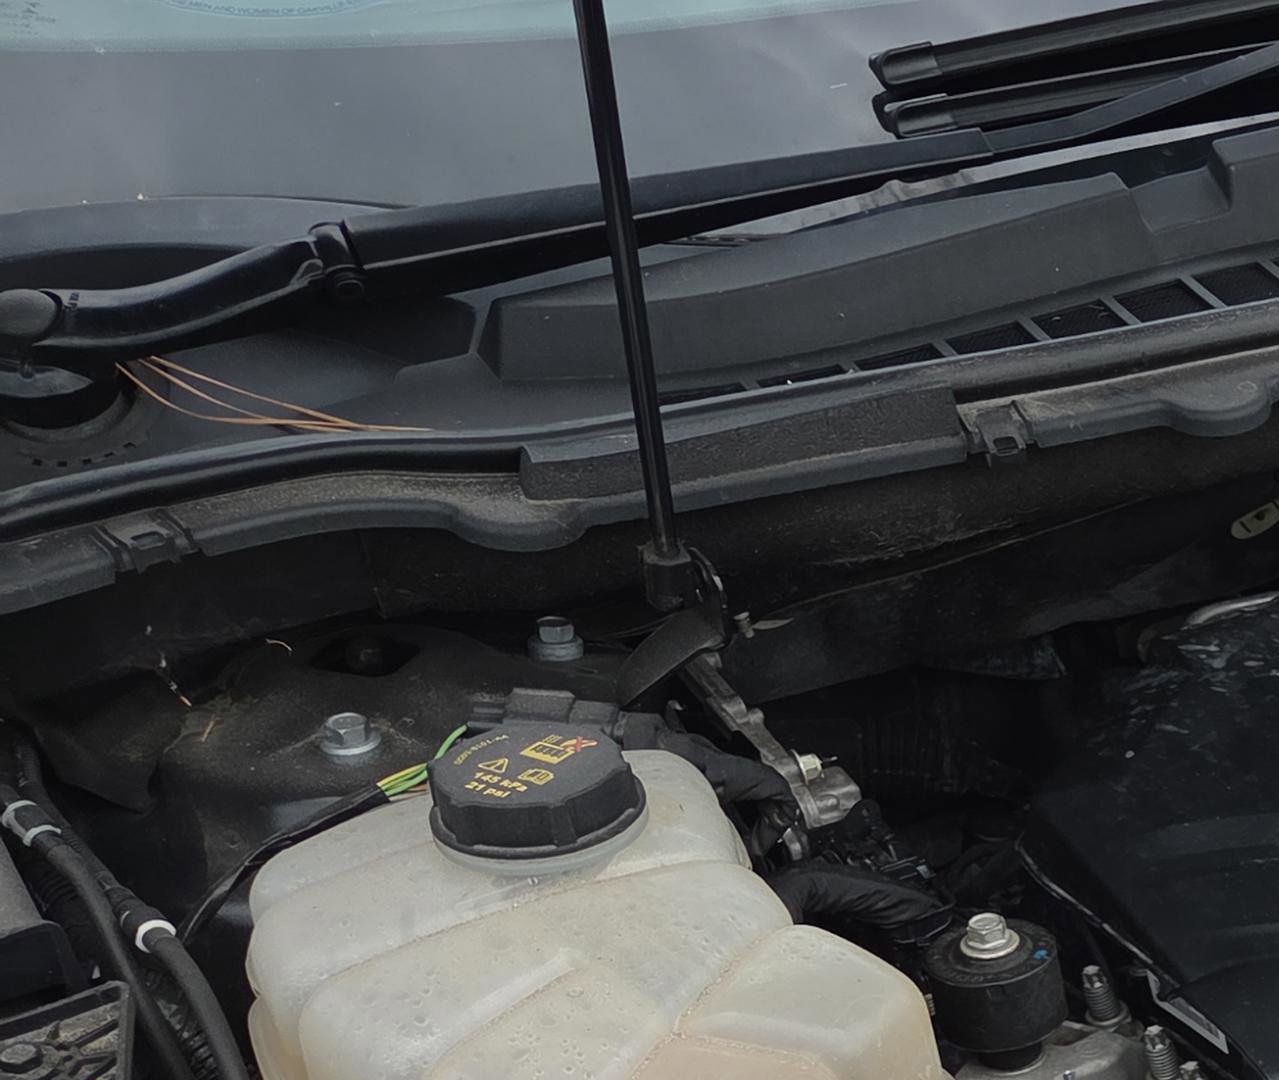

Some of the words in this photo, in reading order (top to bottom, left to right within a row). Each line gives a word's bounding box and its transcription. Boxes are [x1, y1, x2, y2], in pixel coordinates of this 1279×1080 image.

[465, 781, 487, 792] 21
[483, 787, 512, 799] psi
[474, 771, 502, 784] 145
[499, 779, 528, 793] kPa
